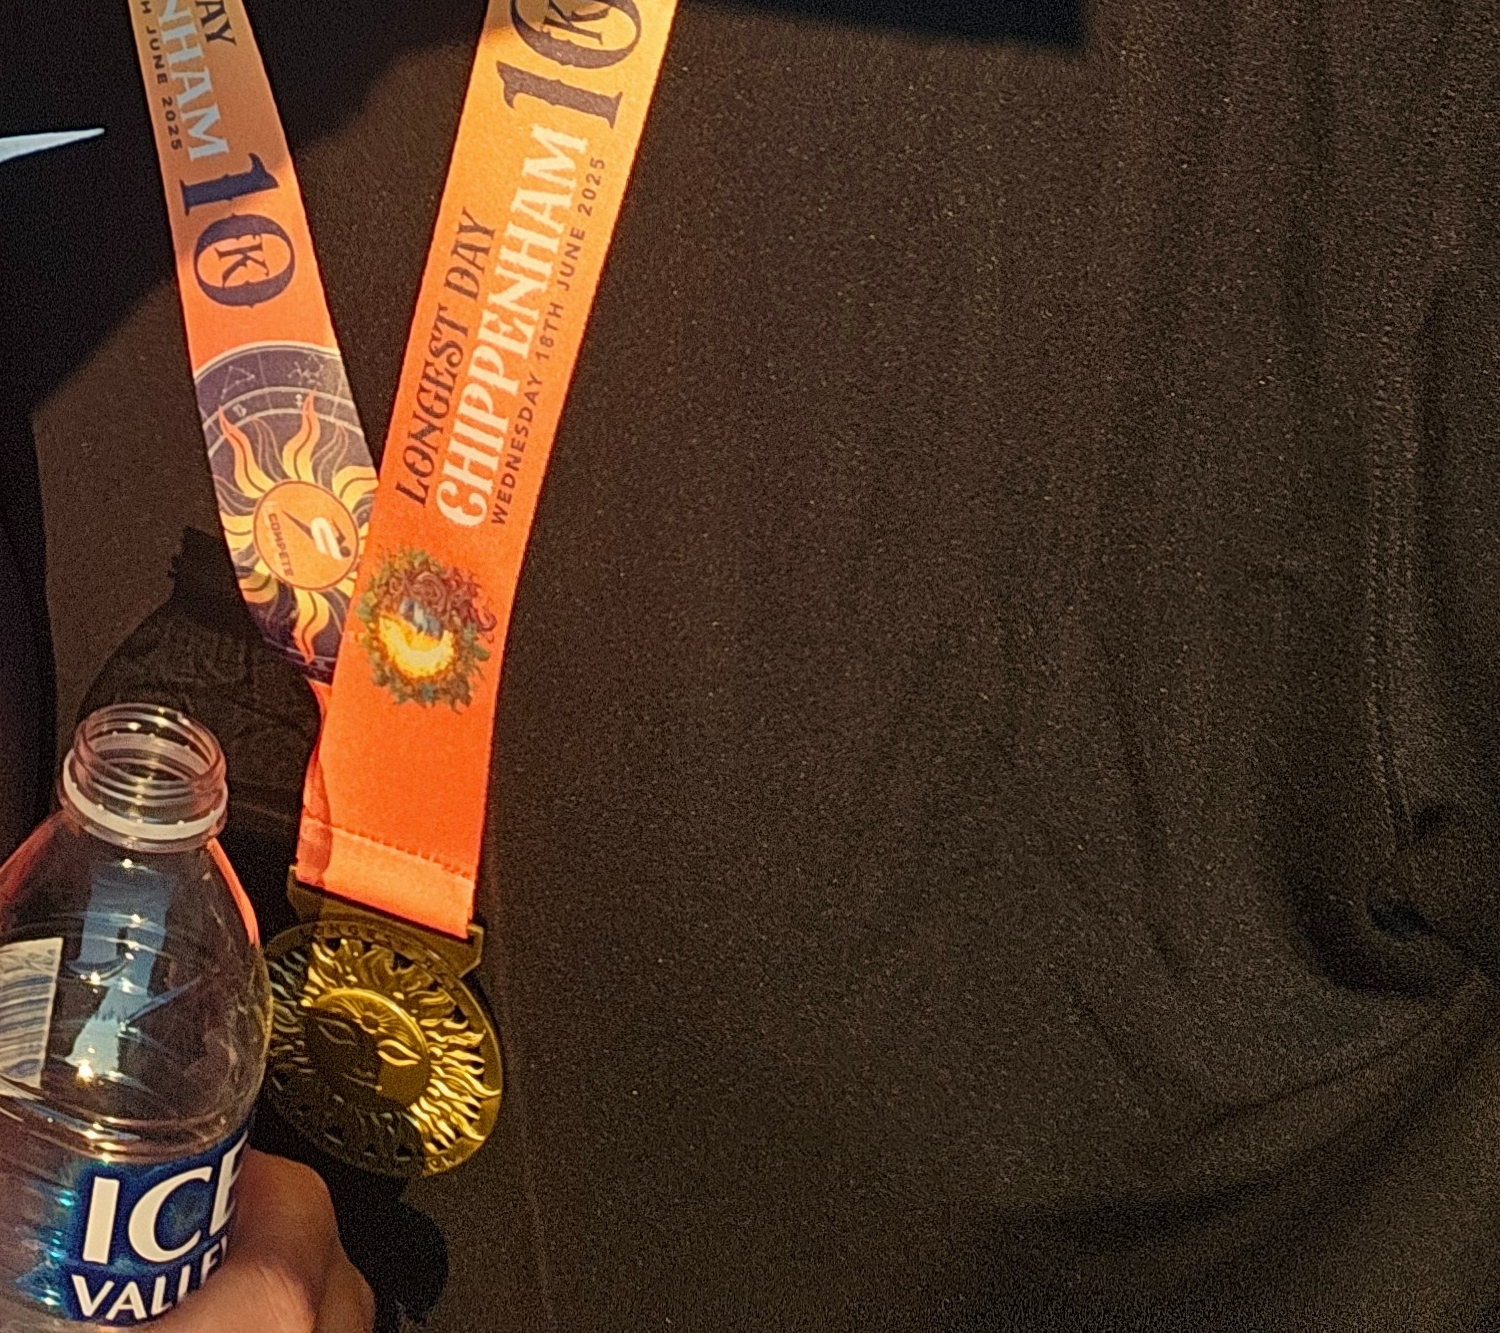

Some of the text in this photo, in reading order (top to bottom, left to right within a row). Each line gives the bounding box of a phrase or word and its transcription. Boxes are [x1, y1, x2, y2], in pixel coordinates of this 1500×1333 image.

[146, 26, 168, 85] JUNE
[162, 96, 183, 151] 2025
[396, 206, 496, 507] LONGEST DAY
[435, 122, 589, 528] CHIPPENHAM
[492, 157, 605, 525] WEDNESDAY 18TH JUNE 2025
